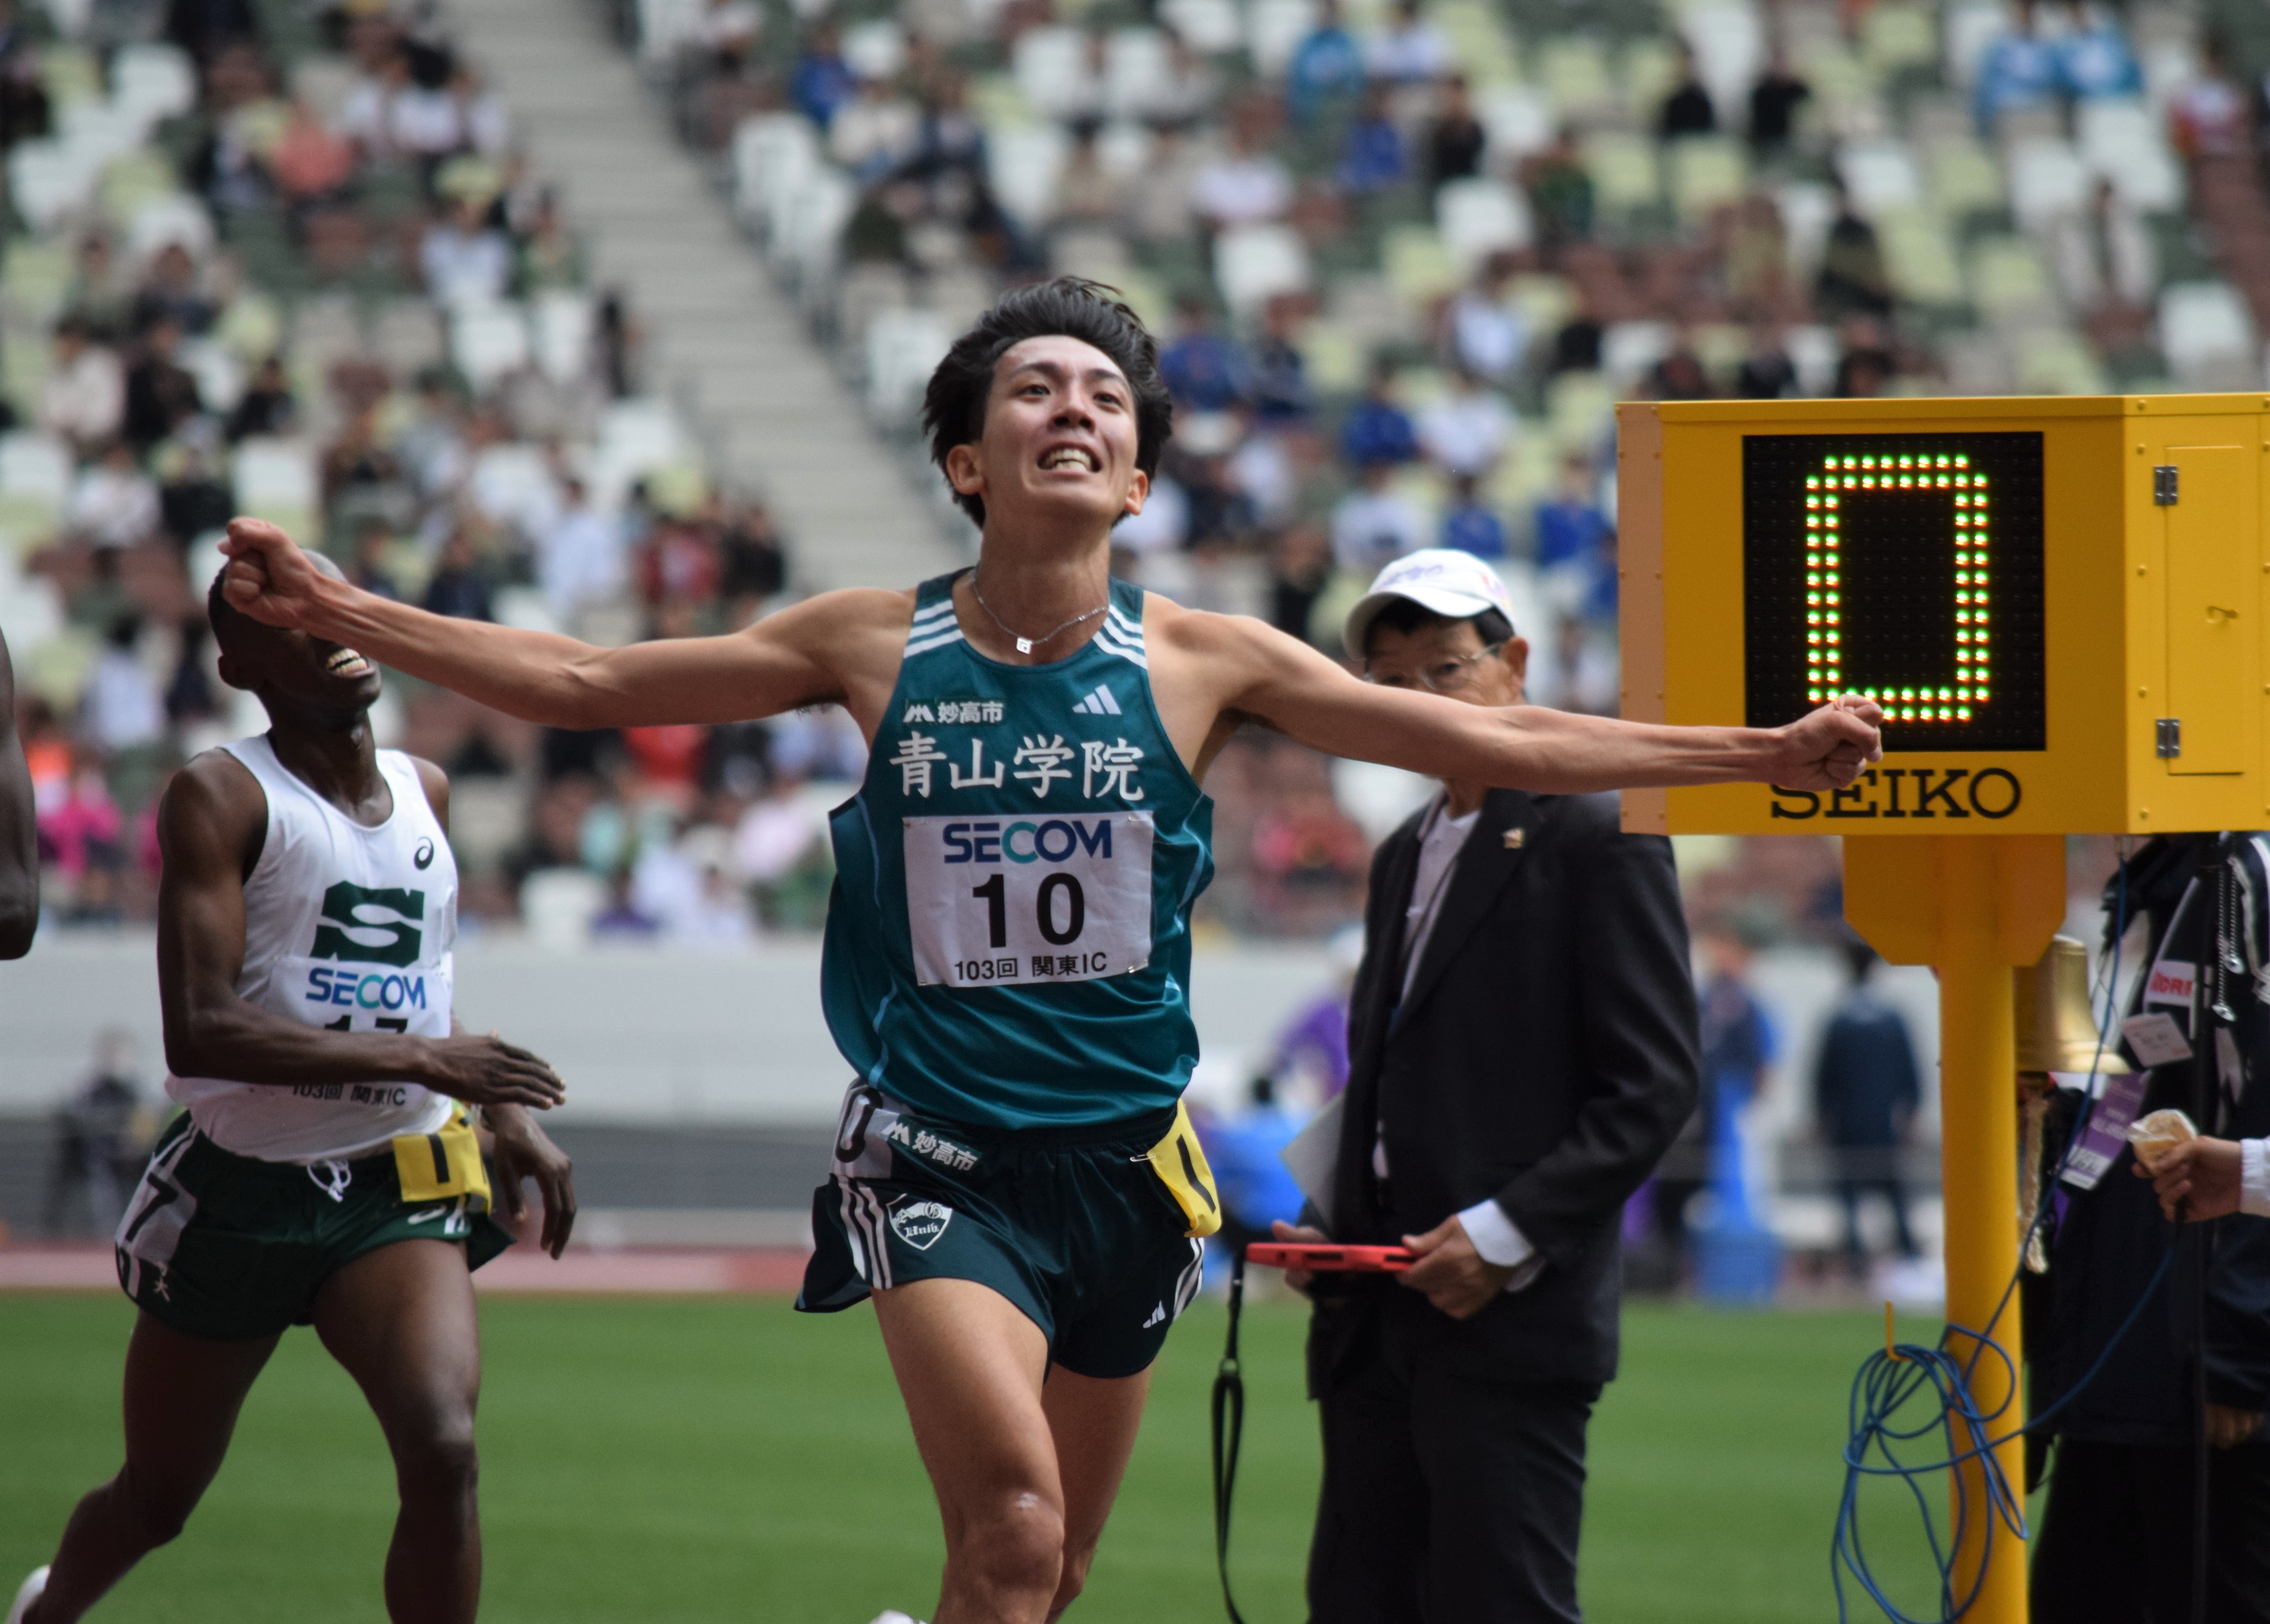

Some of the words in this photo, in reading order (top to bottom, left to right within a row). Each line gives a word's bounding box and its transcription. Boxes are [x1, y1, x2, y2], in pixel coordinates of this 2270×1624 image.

[937, 700, 1003, 724] 妙高市
[889, 731, 1145, 801] 青山学院
[943, 820, 1112, 864] SECOM
[972, 872, 1085, 949] 10
[954, 958, 1018, 980] 103回
[1031, 952, 1107, 977] 関東IC
[305, 967, 427, 1010] SECOM
[912, 1130, 978, 1171] 妙高市
